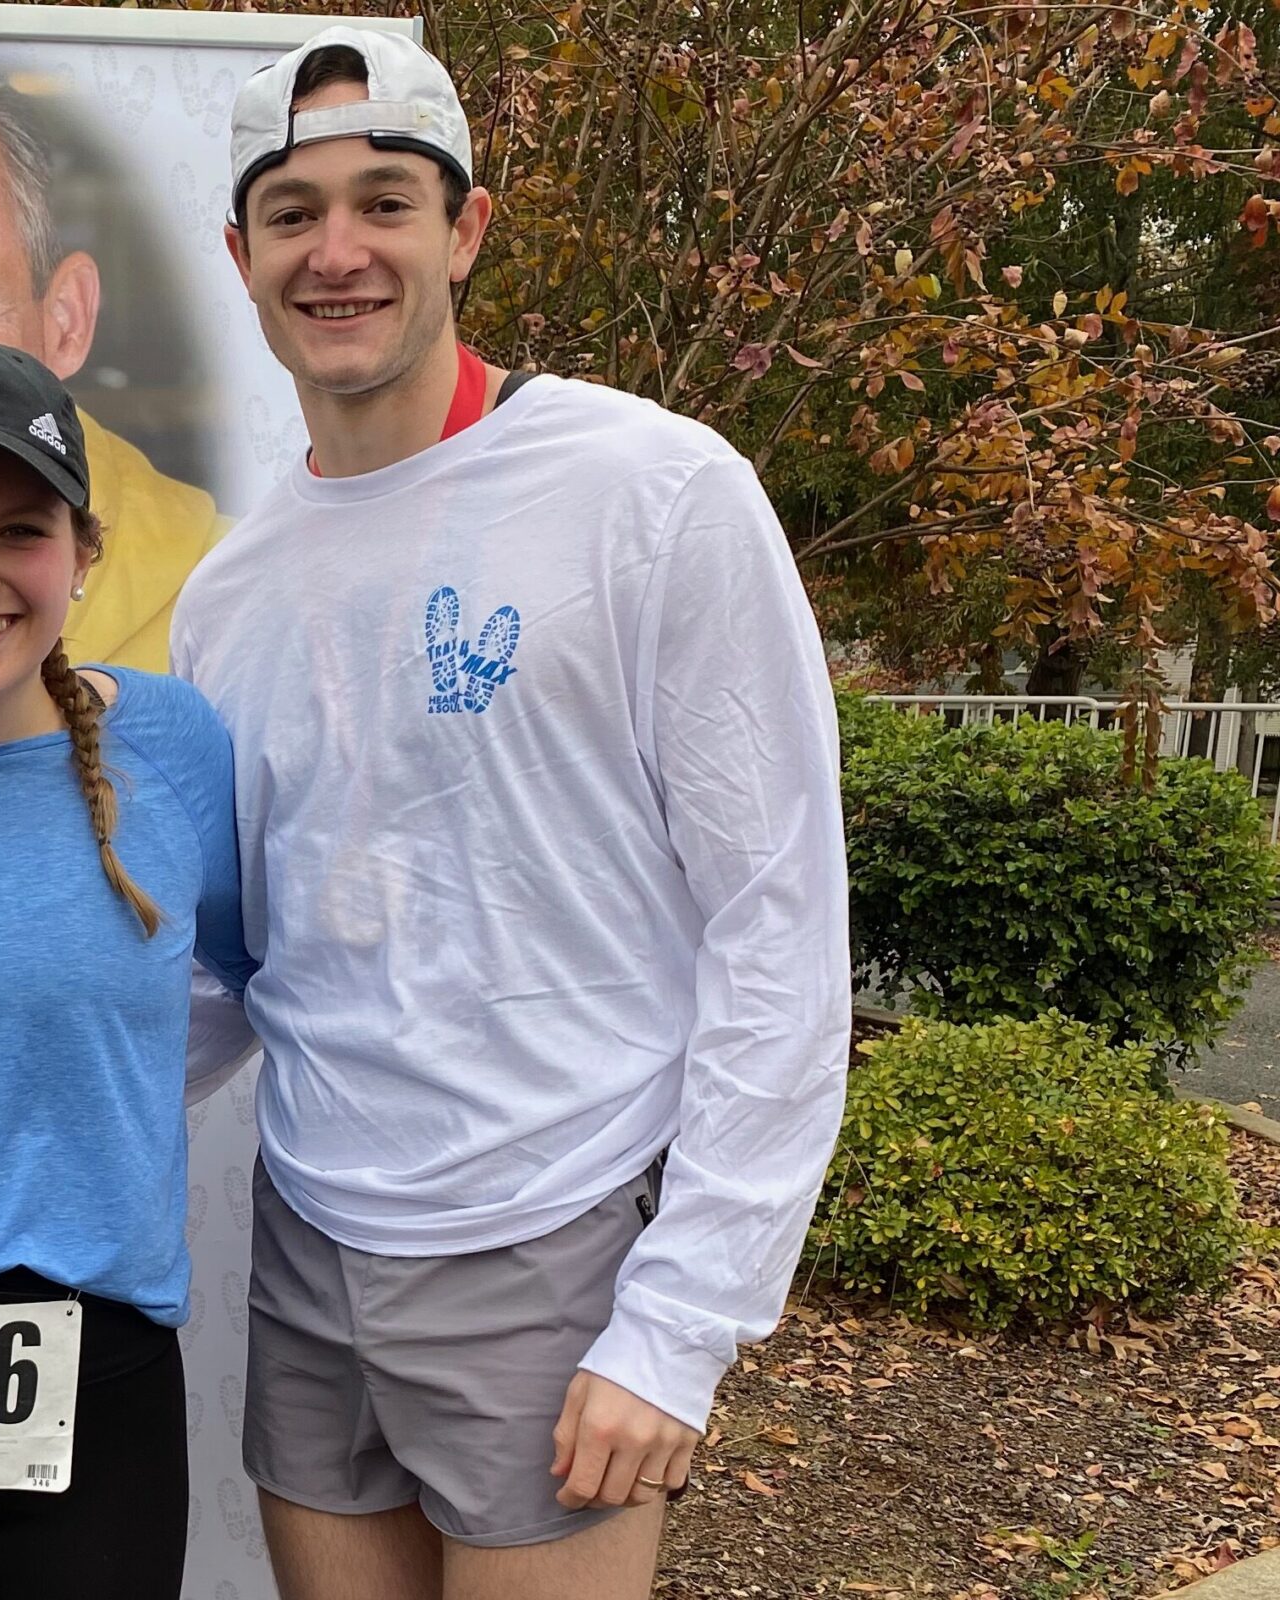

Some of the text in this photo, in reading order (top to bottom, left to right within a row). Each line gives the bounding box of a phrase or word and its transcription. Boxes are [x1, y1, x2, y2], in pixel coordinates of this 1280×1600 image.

[29, 425, 66, 455] adidas
[426, 638, 518, 685] TRAX 4 MAX
[436, 704, 463, 713] SOUL
[32, 1478, 50, 1487] 346
